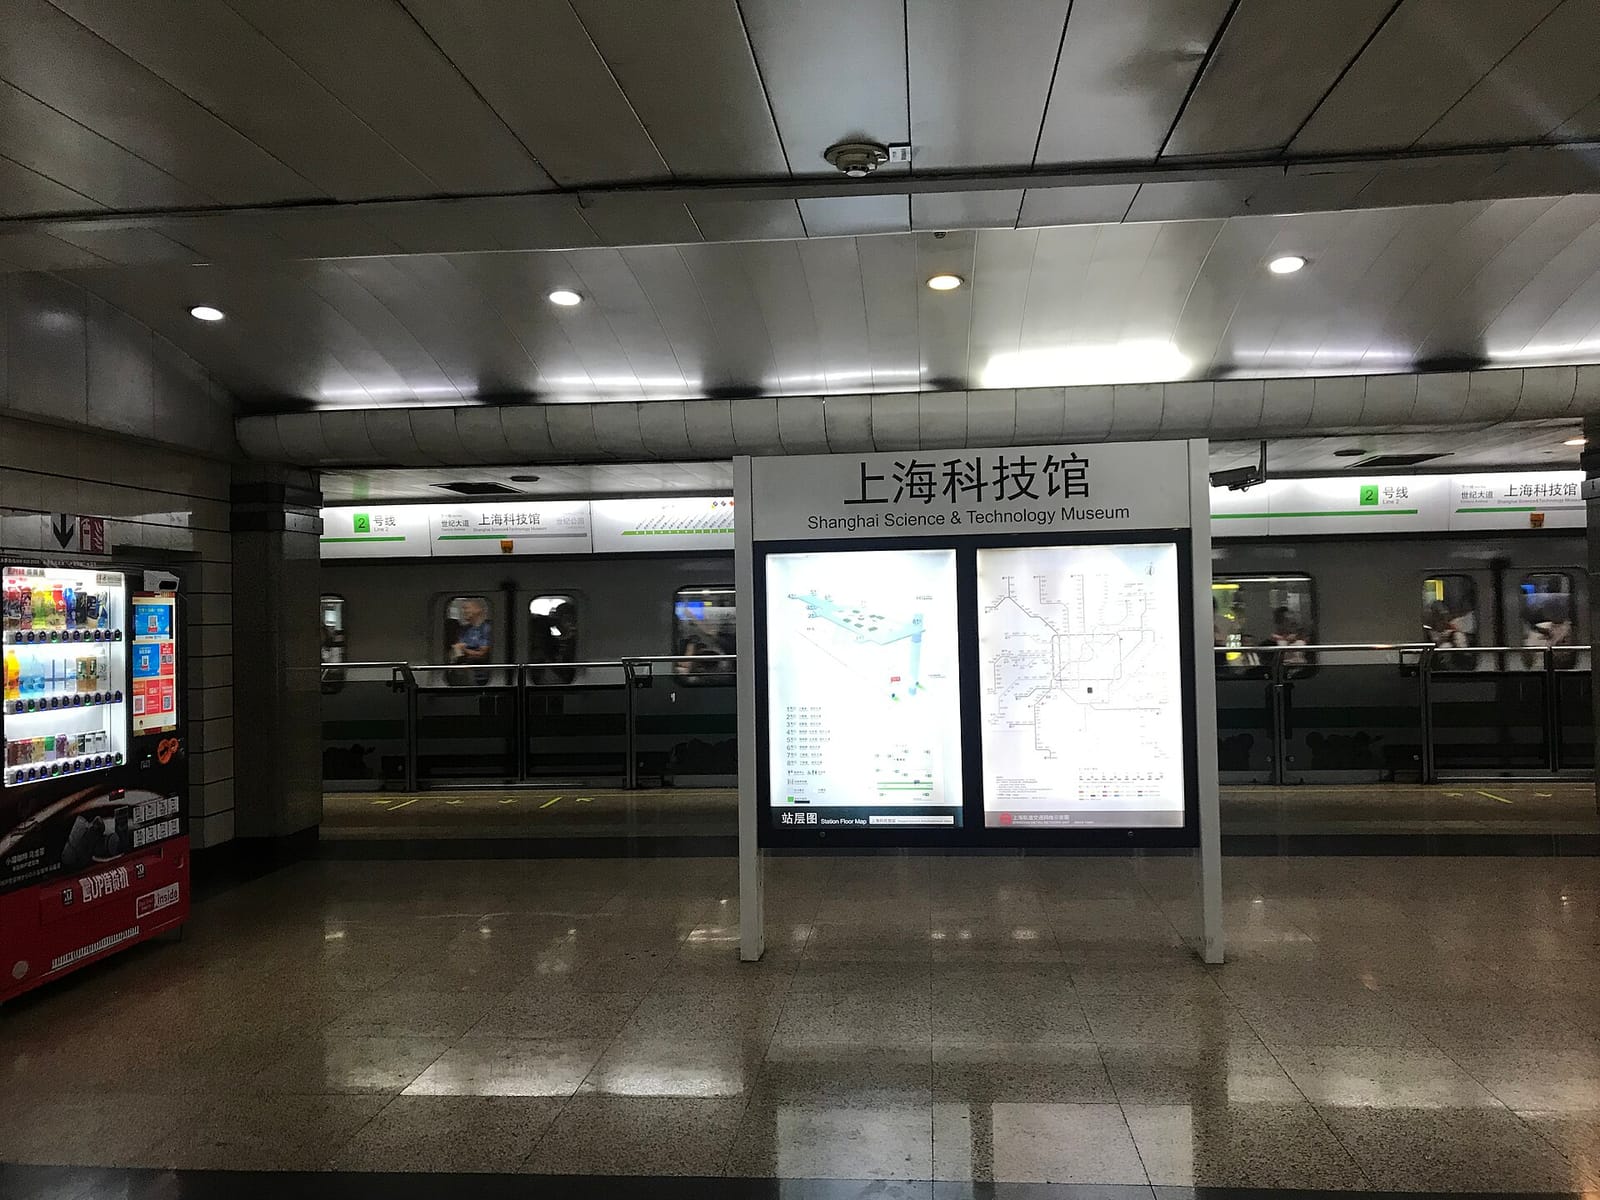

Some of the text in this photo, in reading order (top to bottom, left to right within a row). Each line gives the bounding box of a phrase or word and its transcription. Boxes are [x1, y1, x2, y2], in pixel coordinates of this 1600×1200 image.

[843, 451, 1091, 505] 上海科技馆
[1365, 486, 1409, 501] 2 号线
[1503, 482, 1578, 497] 上海科技馆
[358, 515, 397, 529] 2 号线
[478, 512, 542, 526] 上海科技馆
[807, 506, 1130, 532] Shanghai Science & Technology Museum
[781, 812, 818, 825] 站层图
[820, 817, 839, 825] Station
[840, 817, 854, 825] Floor
[854, 817, 868, 826] Map
